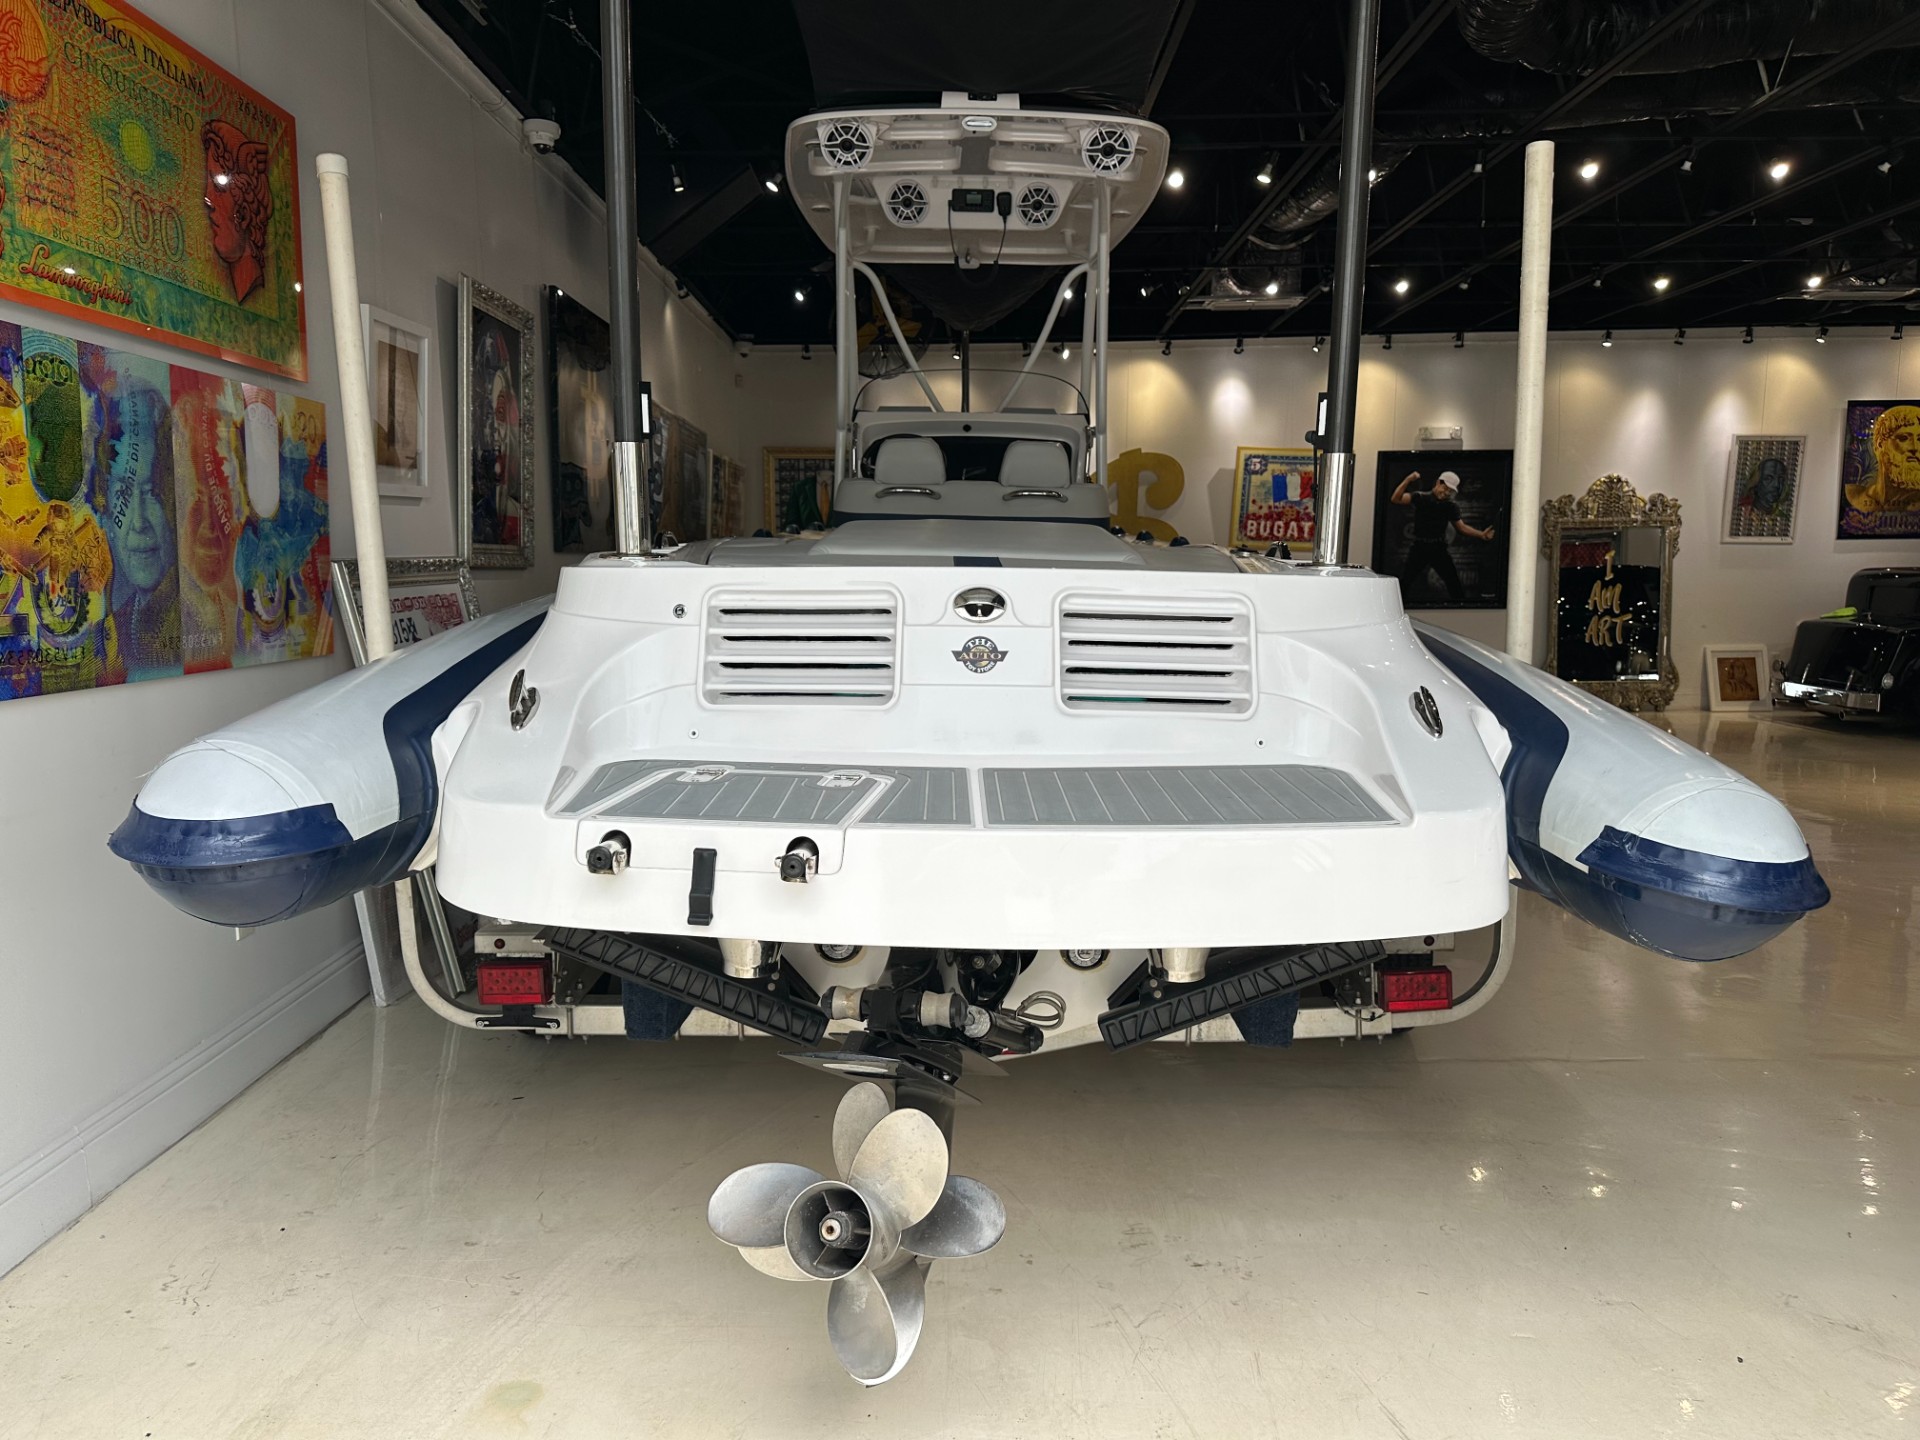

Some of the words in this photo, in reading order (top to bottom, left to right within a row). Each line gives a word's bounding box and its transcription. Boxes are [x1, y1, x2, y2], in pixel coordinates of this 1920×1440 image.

[143, 44, 206, 100] ITALIANA
[100, 174, 184, 263] 500
[203, 452, 213, 473] DU
[1251, 457, 1261, 470] 5
[207, 476, 232, 535] BANQUE
[1604, 550, 1616, 581] I
[965, 637, 995, 651] THE
[1585, 613, 1633, 647] ART
[959, 652, 1002, 660] AUTO
